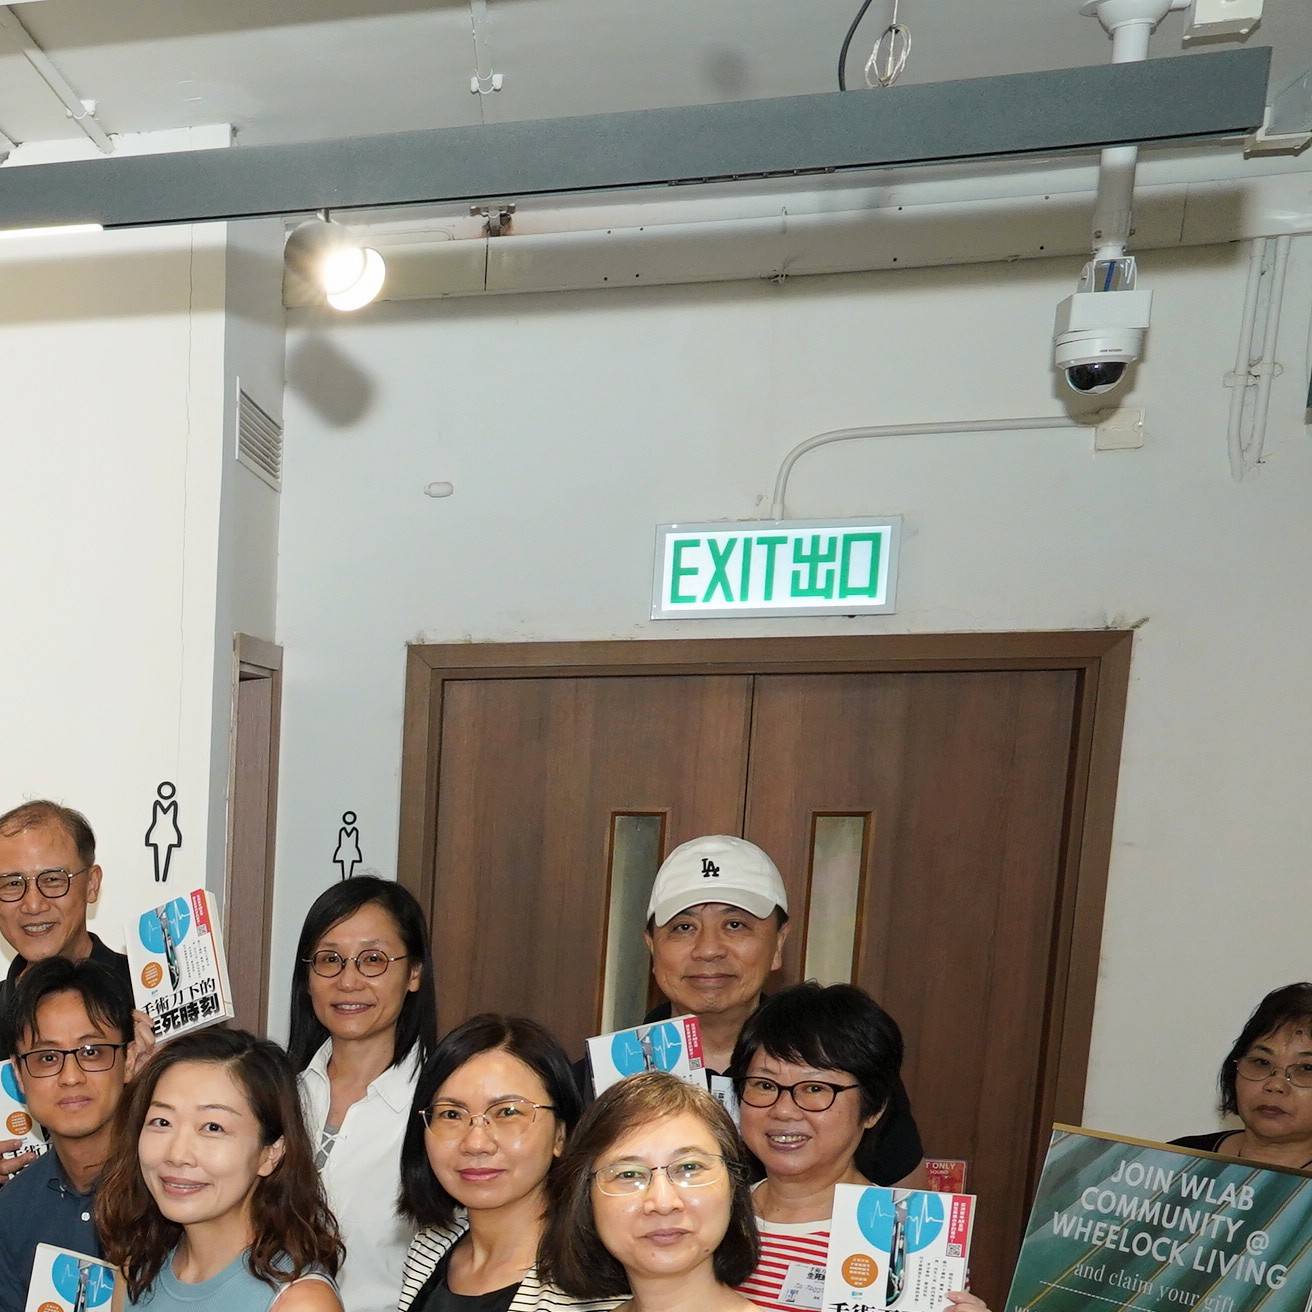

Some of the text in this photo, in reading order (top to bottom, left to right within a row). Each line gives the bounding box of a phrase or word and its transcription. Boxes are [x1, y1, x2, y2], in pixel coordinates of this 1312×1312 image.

[670, 535, 788, 603] EXIT
[790, 532, 882, 599] 出口
[701, 858, 720, 878] LA
[1111, 1160, 1255, 1211] JOIN WLAB
[1051, 1211, 1289, 1290] WHEELOCK LIVING
[1080, 1186, 1270, 1256] COMMUNITY @
[1073, 1262, 1106, 1284] and
[1109, 1270, 1154, 1296] claim
[1156, 1283, 1200, 1308] your
